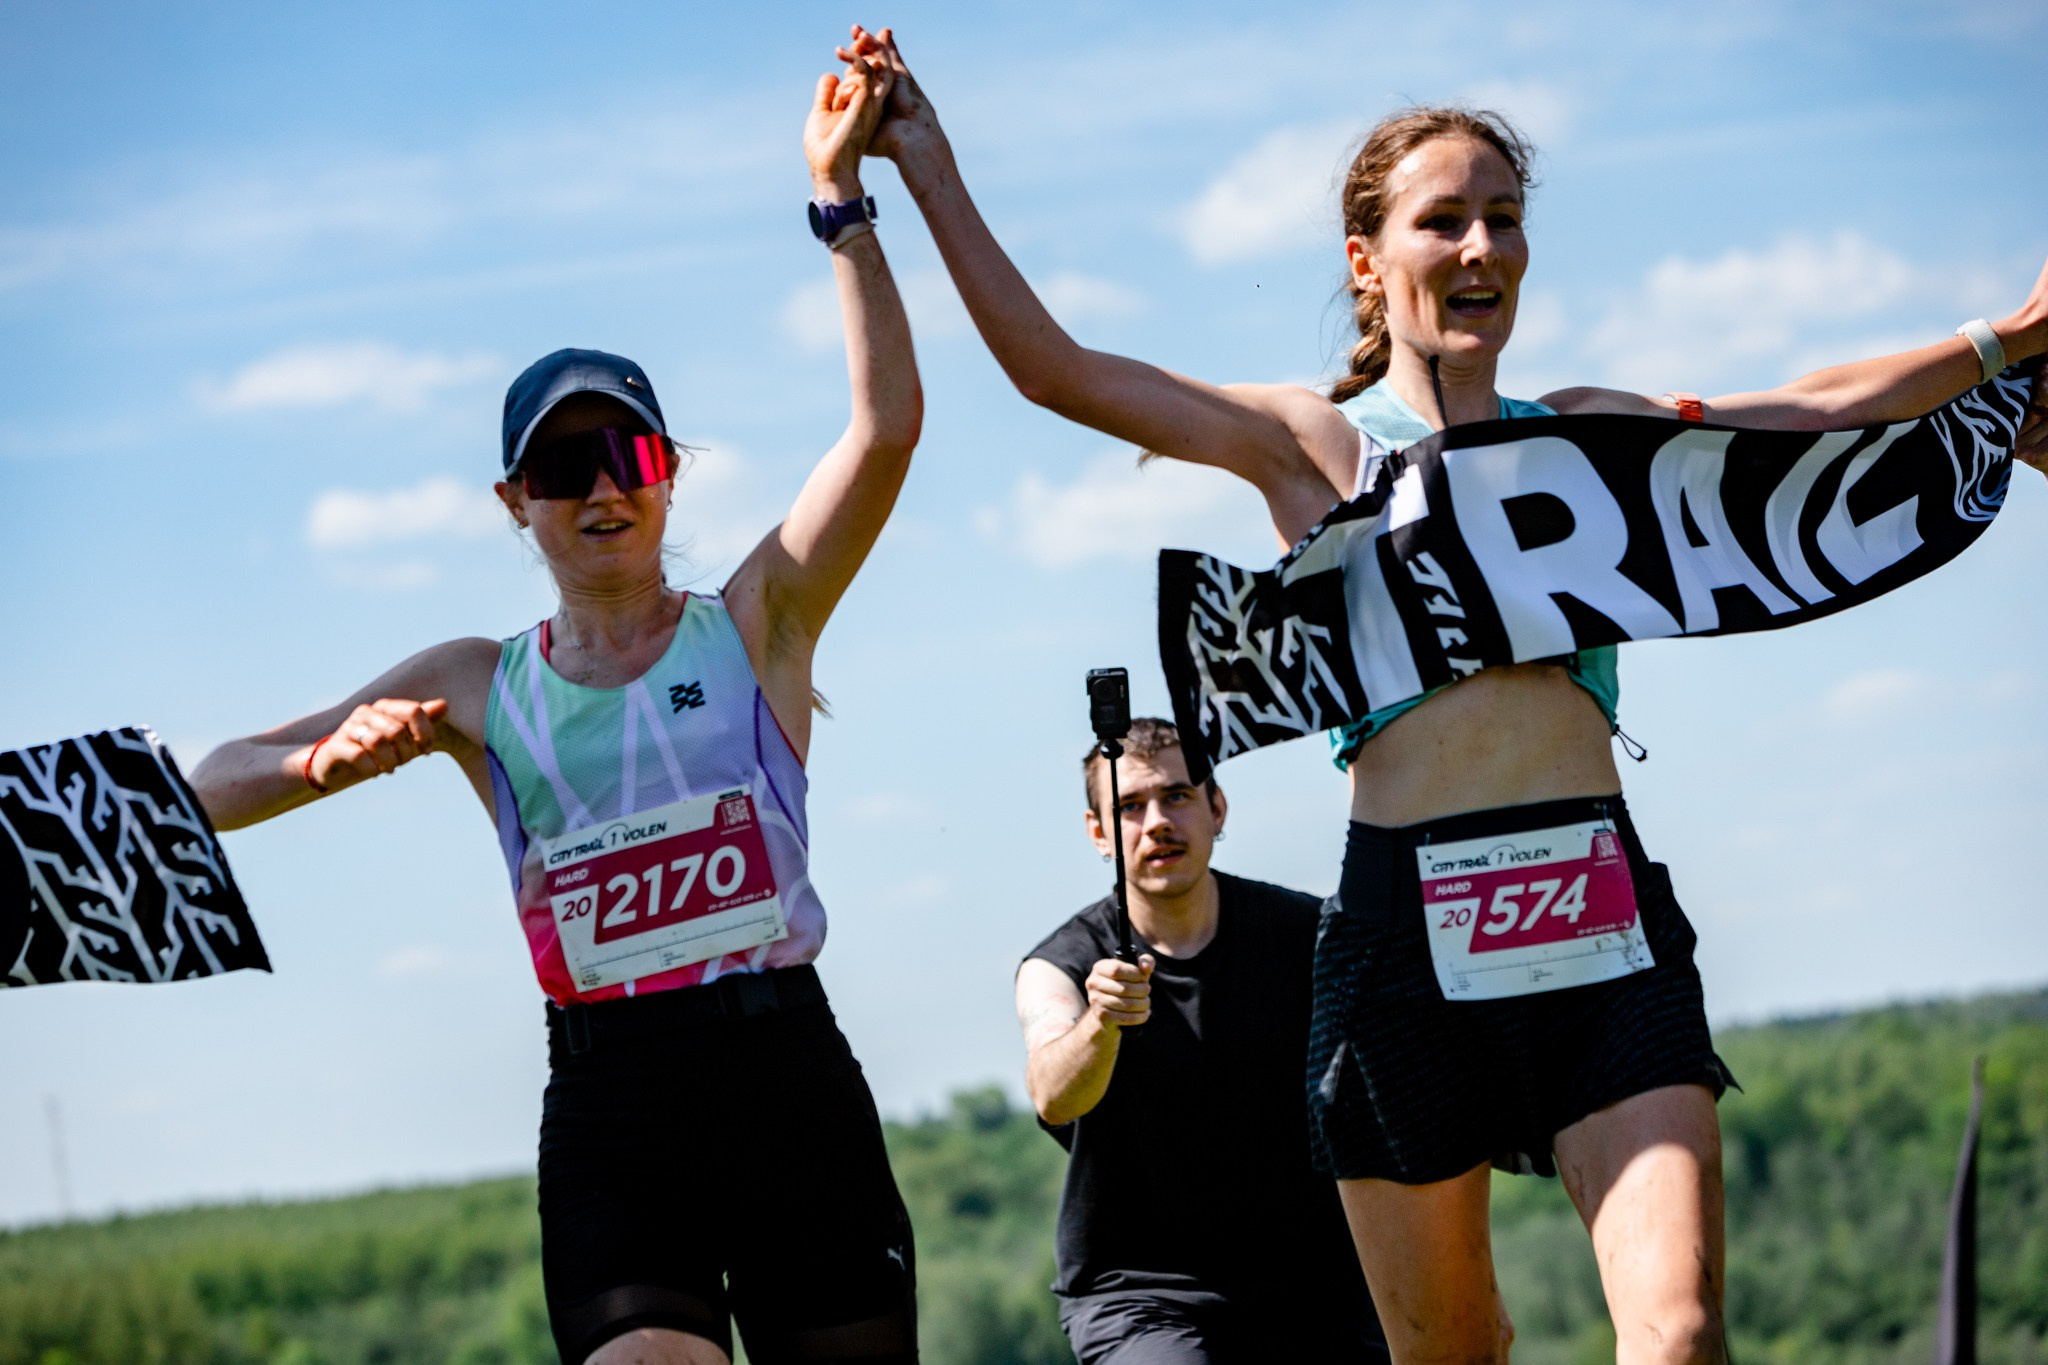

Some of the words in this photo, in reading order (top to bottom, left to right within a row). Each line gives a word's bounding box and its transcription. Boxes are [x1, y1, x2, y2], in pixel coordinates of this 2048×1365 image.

[623, 821, 668, 843] VOLEN
[1509, 847, 1552, 864] VOLEN
[554, 868, 589, 888] HARD
[601, 844, 747, 930] 2170
[1434, 881, 1472, 897] HARD
[561, 896, 592, 923] 20
[1481, 872, 1589, 937] 574
[1439, 907, 1471, 930] 20
